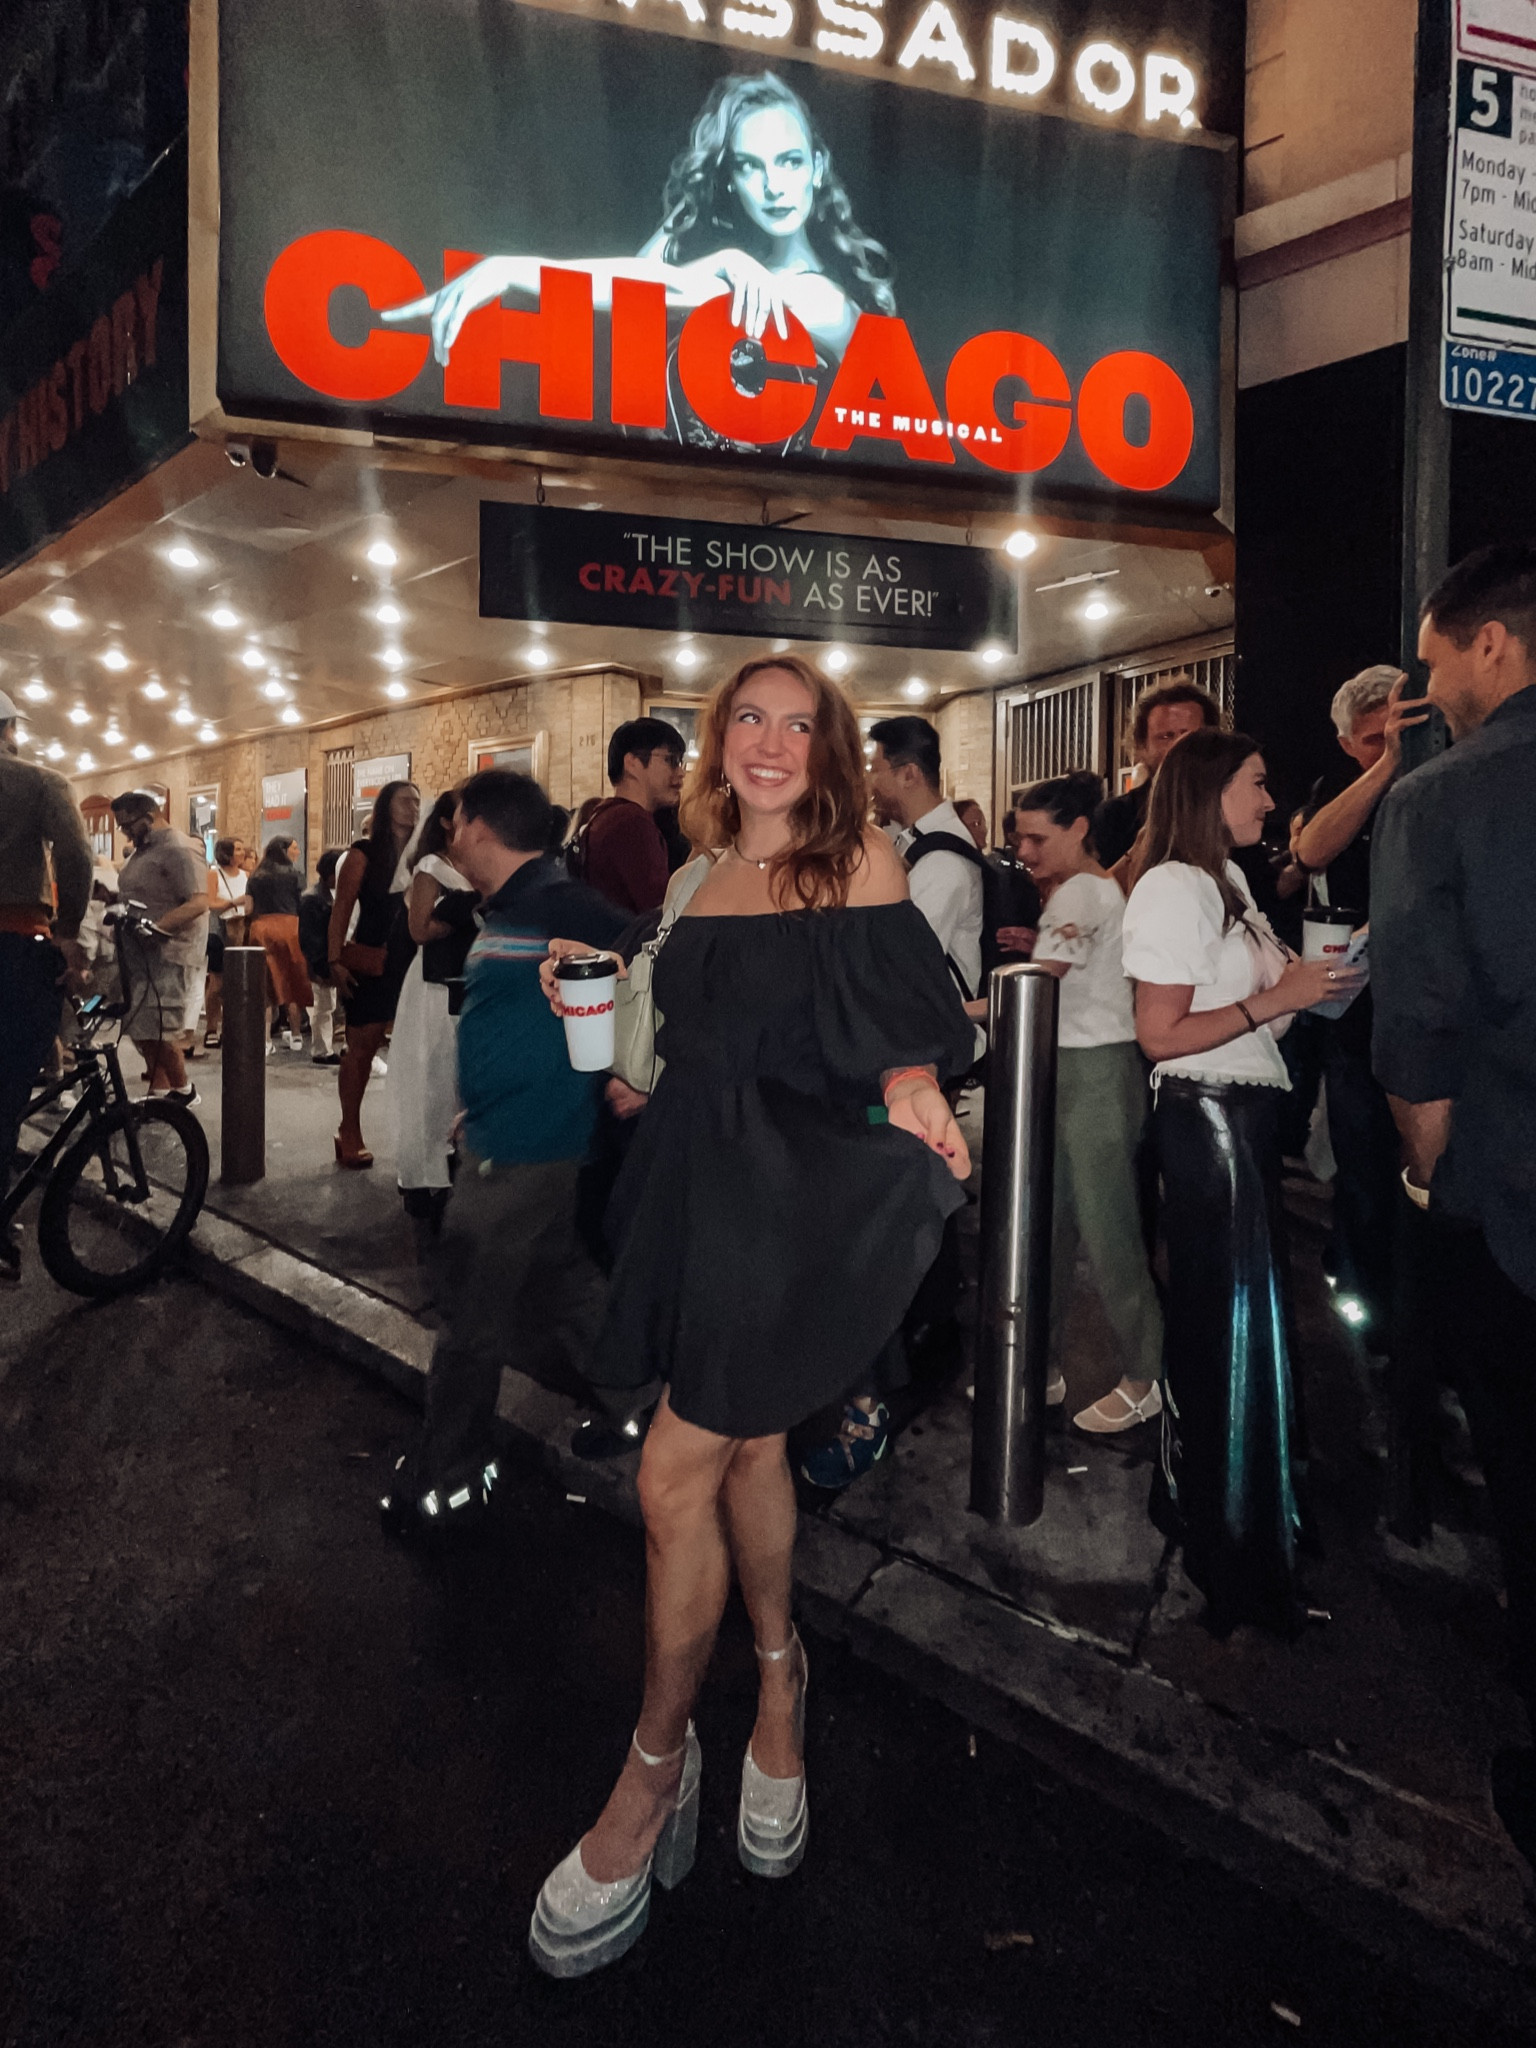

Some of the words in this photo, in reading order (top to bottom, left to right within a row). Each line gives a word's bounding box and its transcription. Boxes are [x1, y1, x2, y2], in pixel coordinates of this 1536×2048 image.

[1470, 68, 1499, 128] 5
[1461, 149, 1526, 186] Monday
[1461, 178, 1495, 206] 7pm
[1459, 219, 1535, 256] Saturday
[1457, 247, 1493, 272] 8am
[264, 229, 1194, 491] CHICAGO
[834, 406, 881, 428] THE
[892, 415, 1003, 443] MUSICAL
[705, 540, 814, 574] SHOW
[827, 551, 851, 579] IS
[862, 554, 901, 582] AS
[578, 562, 791, 605] CRAZY-FUN
[803, 582, 845, 611] AS
